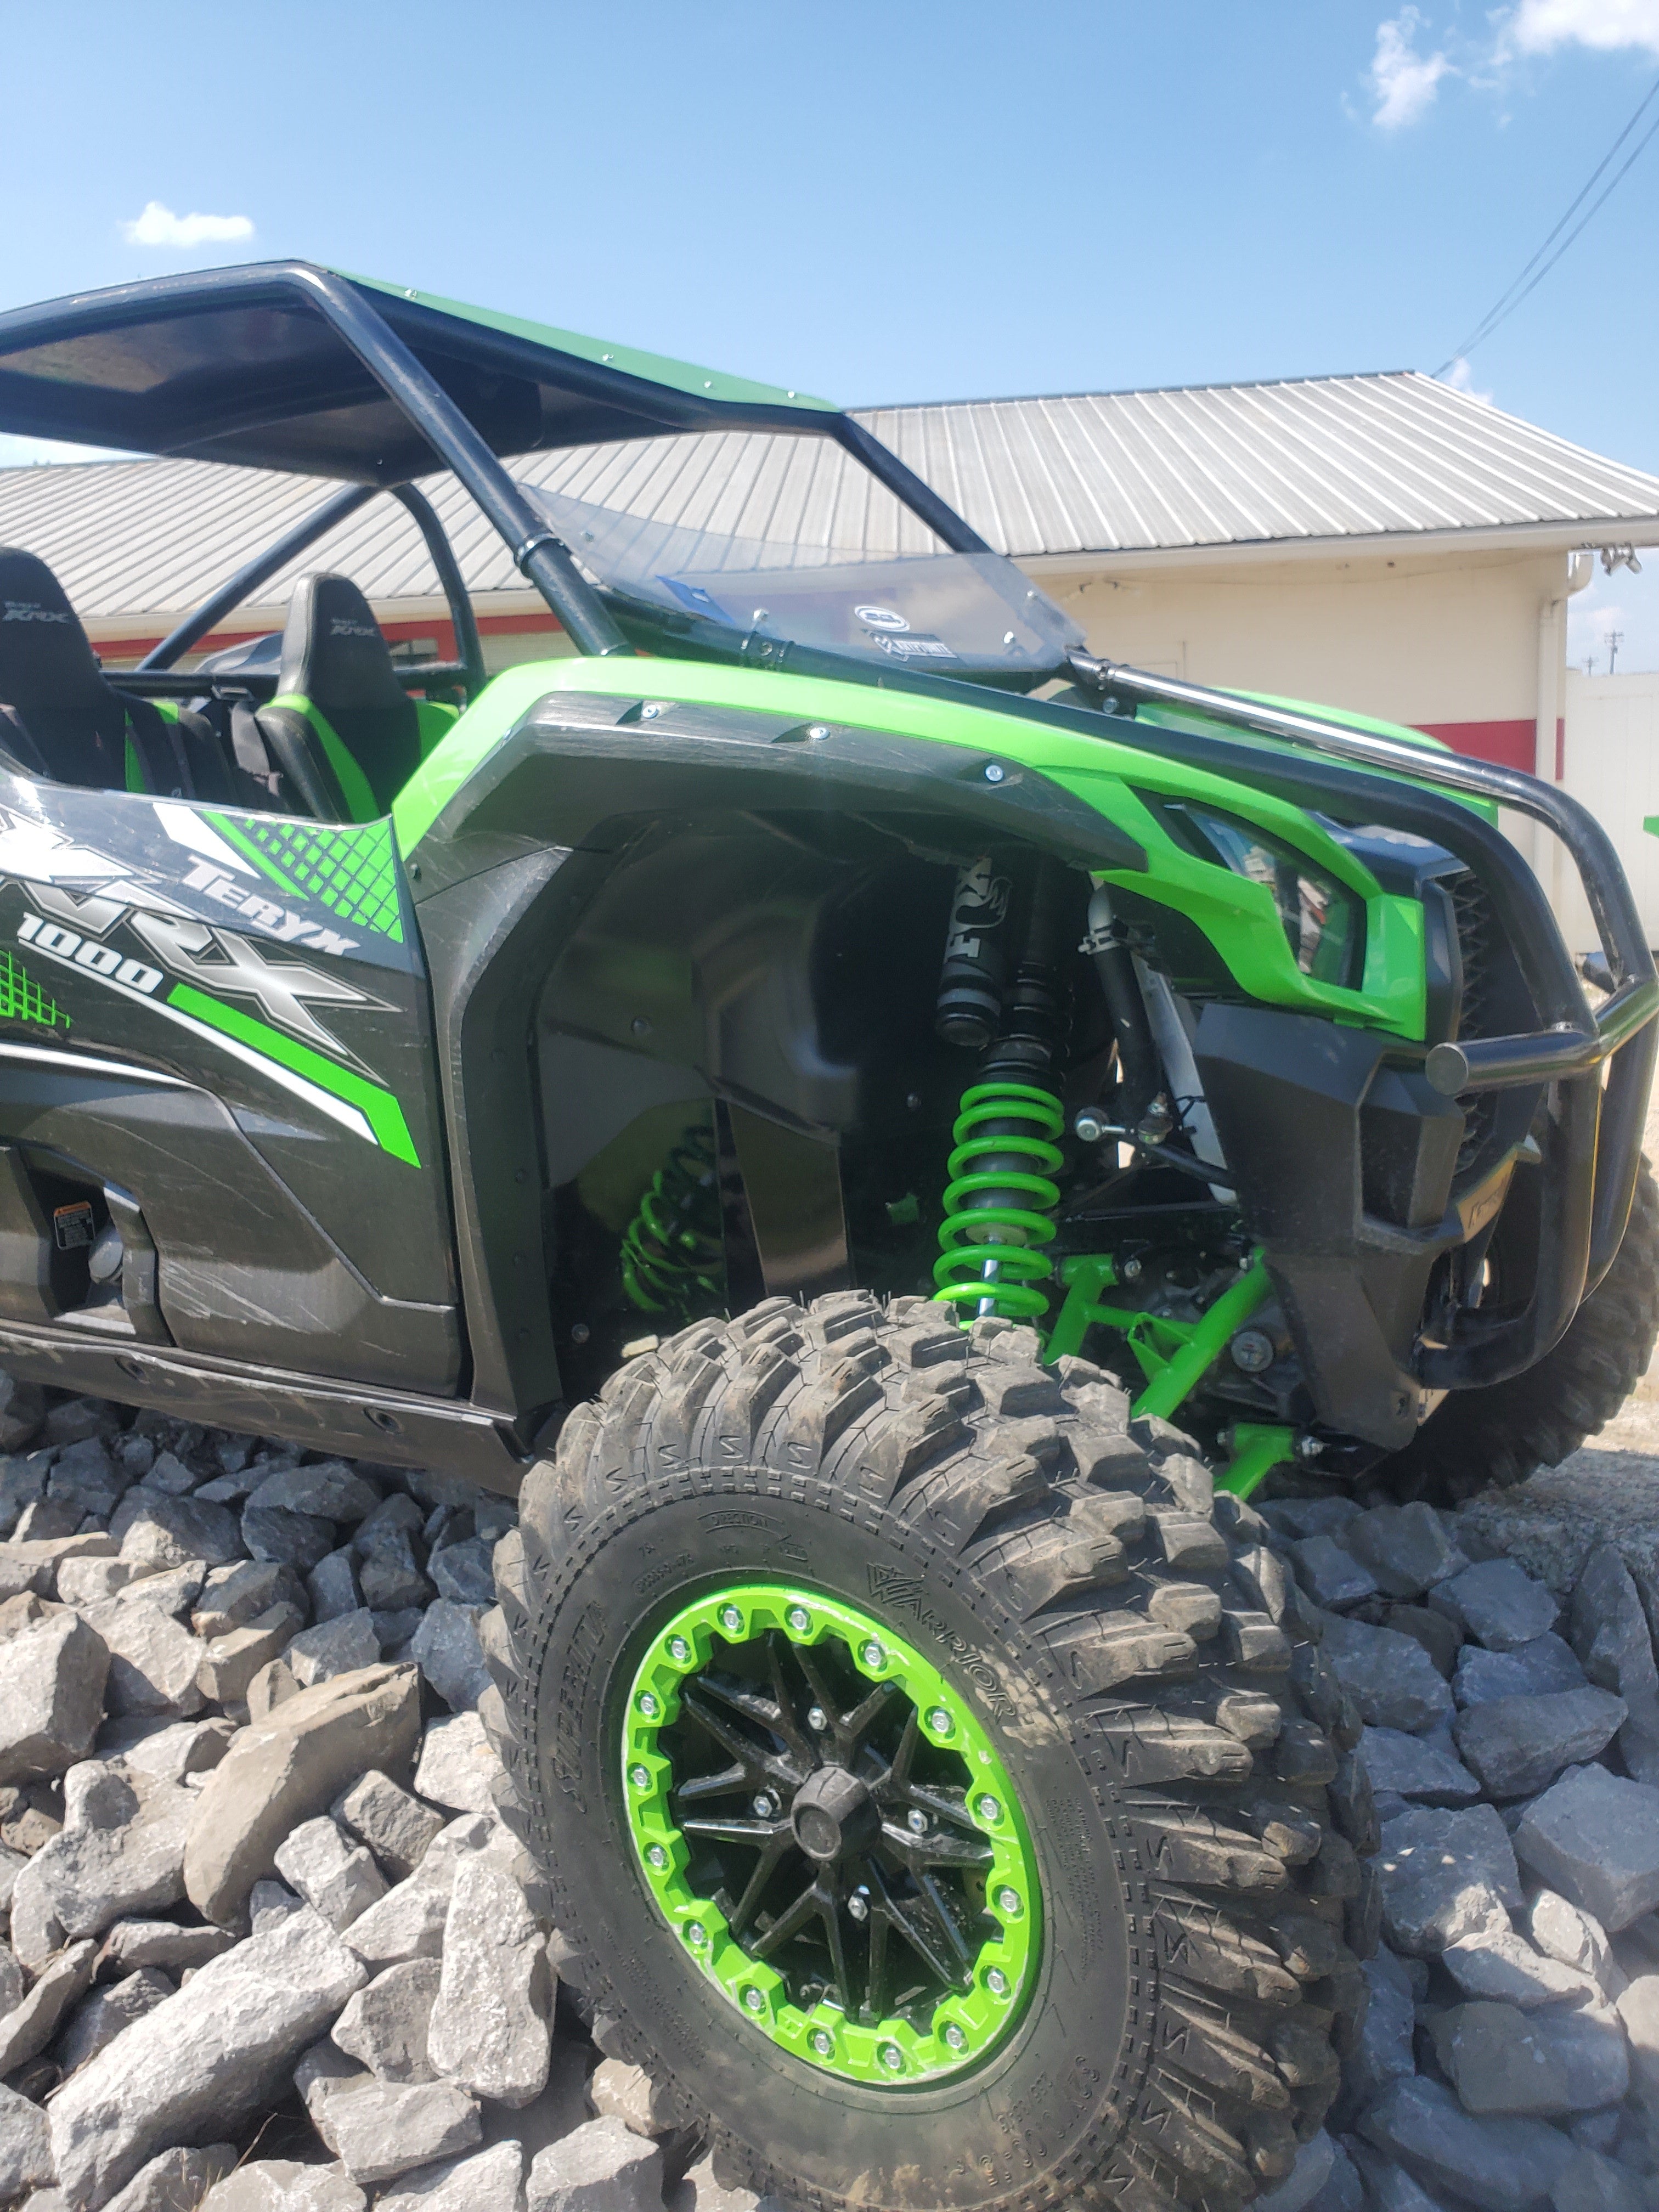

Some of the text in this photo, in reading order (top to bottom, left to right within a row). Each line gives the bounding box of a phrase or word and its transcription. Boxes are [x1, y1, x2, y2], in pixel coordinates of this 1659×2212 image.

[16, 911, 163, 993] 1000
[182, 855, 361, 956] TERYX
[943, 857, 1011, 964] FOX
[867, 1563, 1016, 1724] WARRIOR
